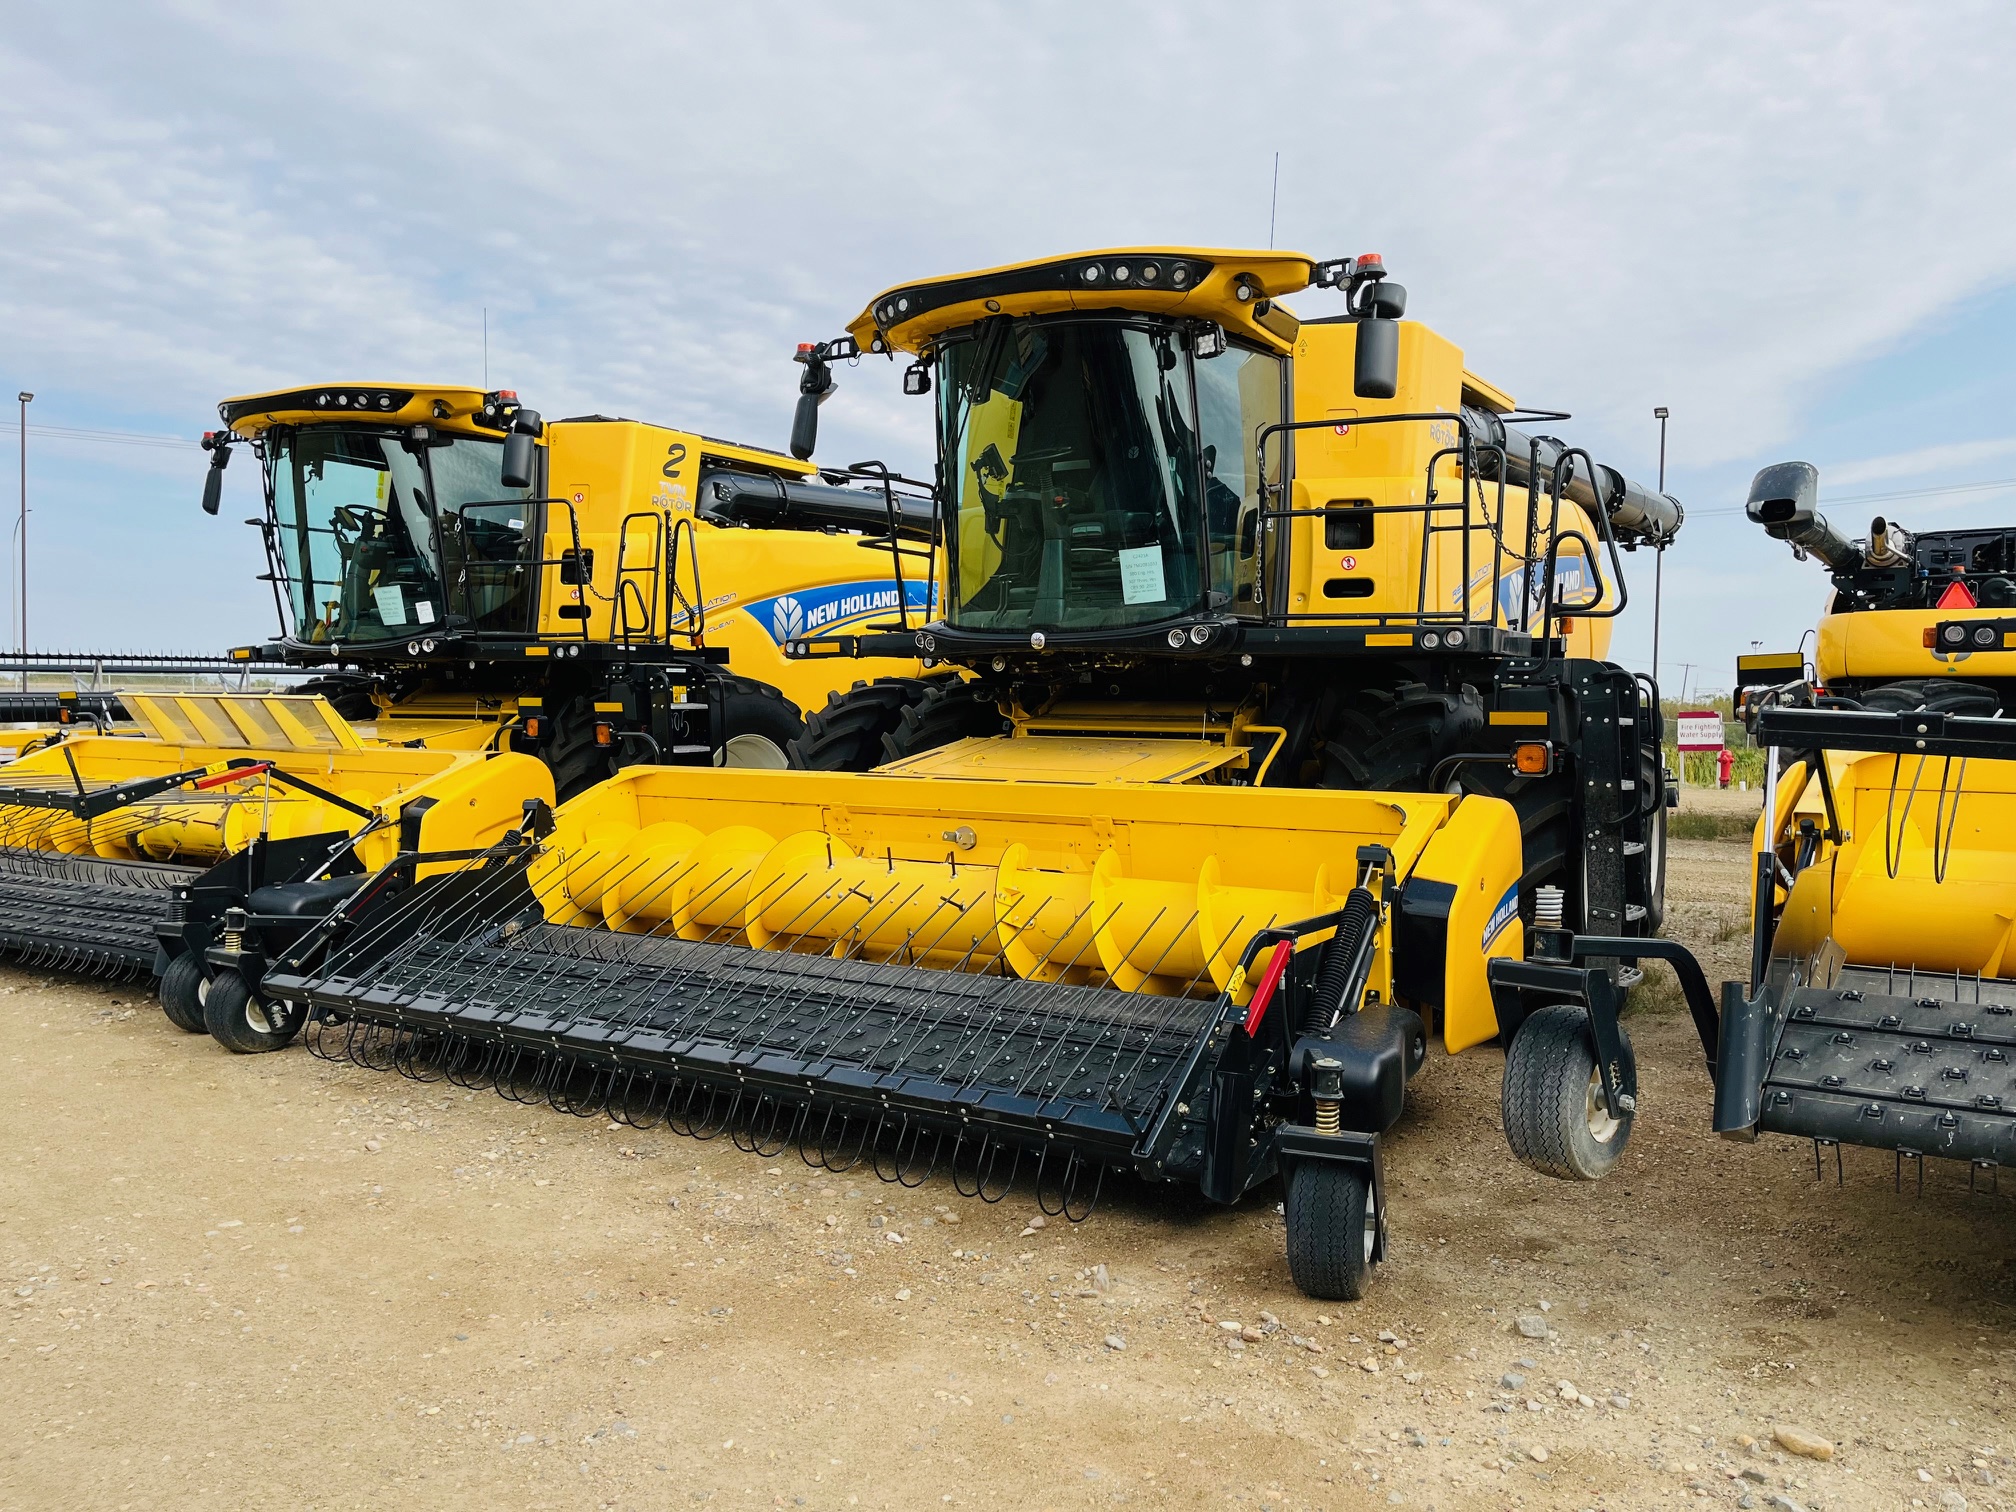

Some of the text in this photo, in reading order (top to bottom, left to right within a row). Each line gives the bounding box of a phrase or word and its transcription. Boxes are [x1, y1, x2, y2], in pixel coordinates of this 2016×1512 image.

[662, 443, 686, 478] 2
[652, 493, 692, 513] ROTOR
[659, 481, 686, 497] TWIN
[807, 590, 900, 630] NEW HOLLAND
[1483, 894, 1518, 944] NEW HOLLAND
